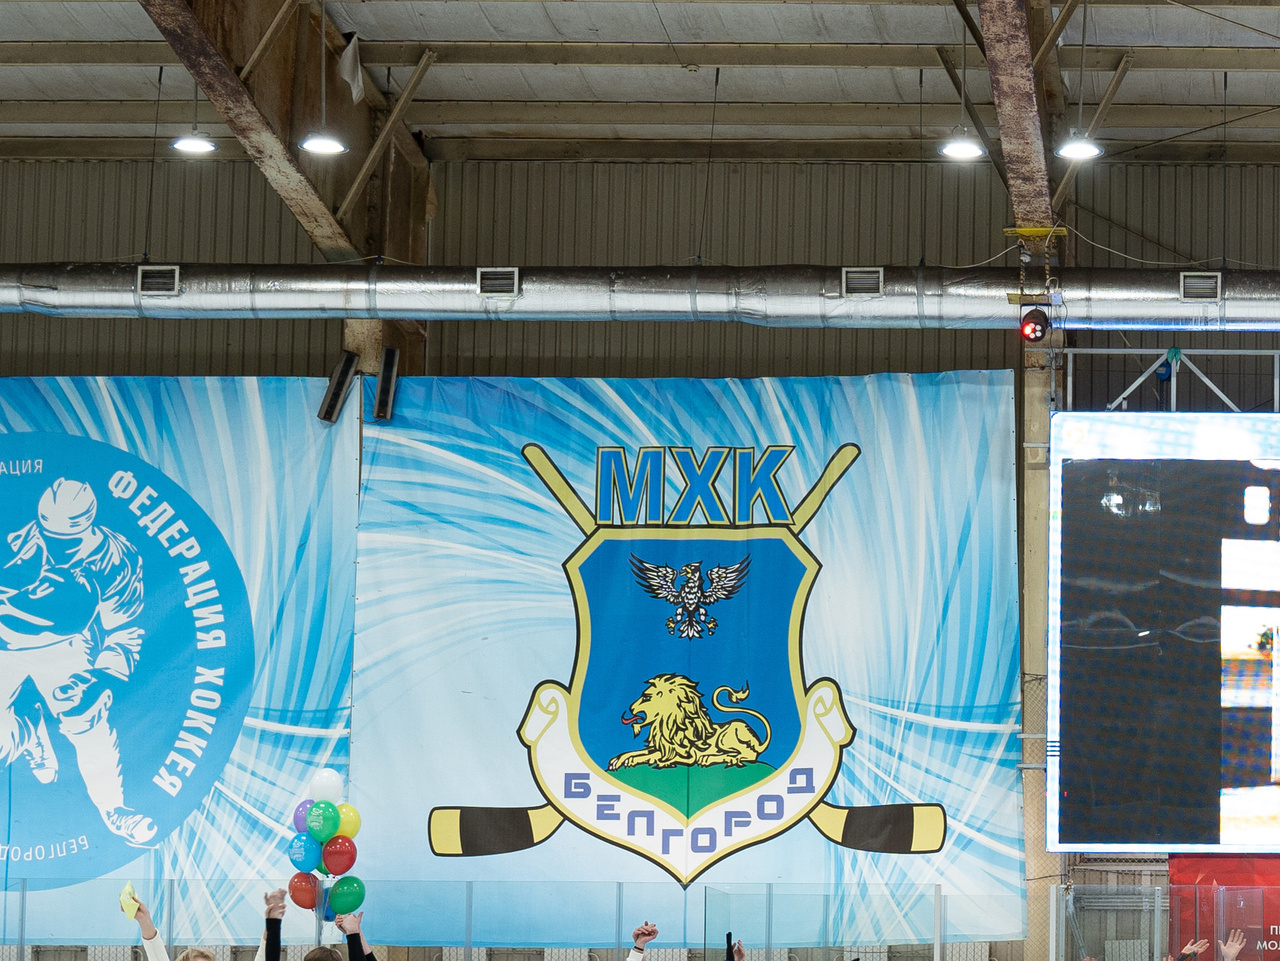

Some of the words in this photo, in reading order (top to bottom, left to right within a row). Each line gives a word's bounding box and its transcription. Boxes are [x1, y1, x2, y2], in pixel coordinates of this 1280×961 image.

[596, 445, 796, 525] МХК
[108, 469, 227, 650] ФЕДЕРАЦИЯ
[153, 666, 226, 797] ХОККЕЯ
[564, 767, 816, 855] БЕЛГОРОД
